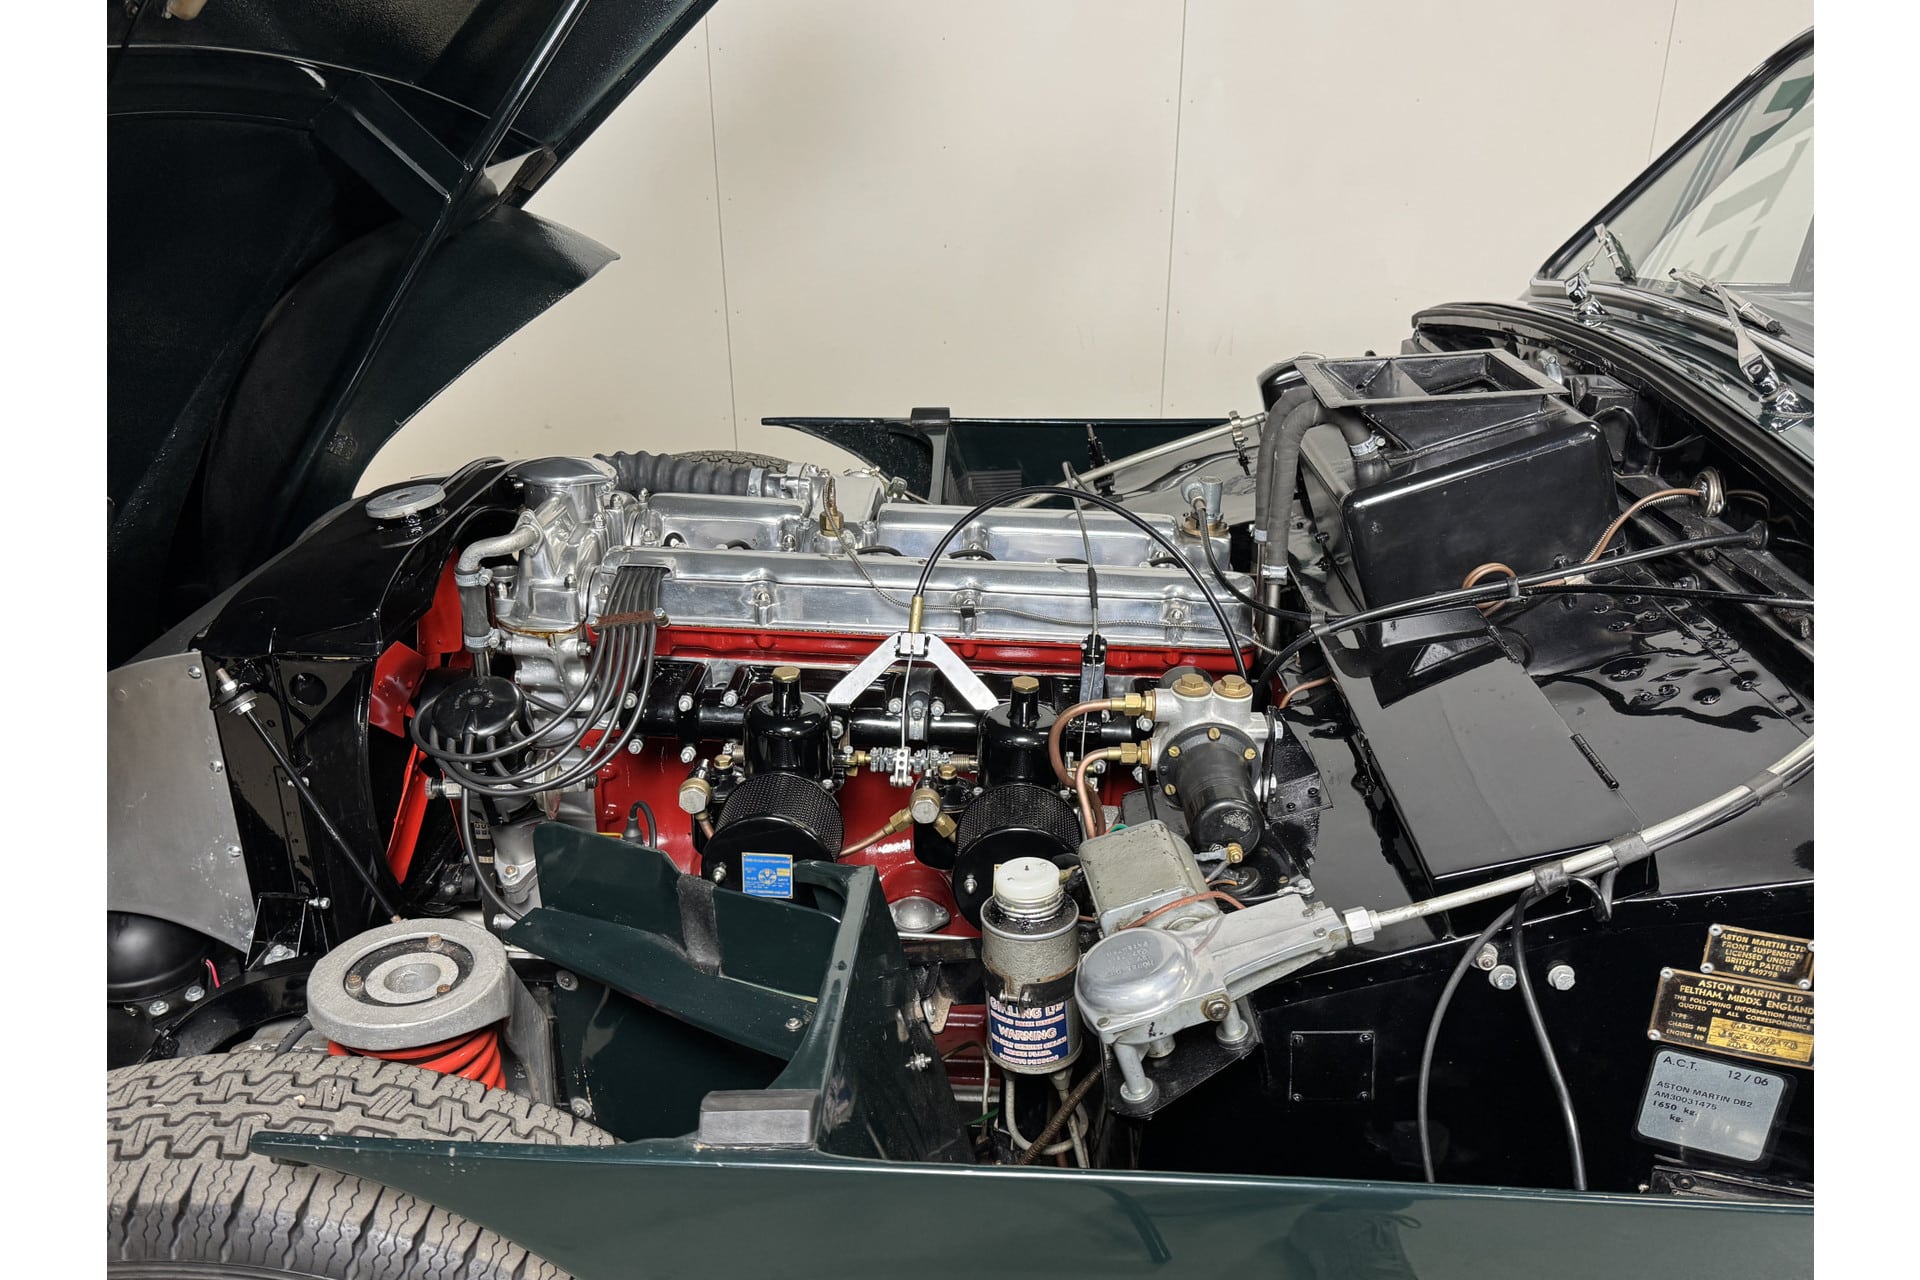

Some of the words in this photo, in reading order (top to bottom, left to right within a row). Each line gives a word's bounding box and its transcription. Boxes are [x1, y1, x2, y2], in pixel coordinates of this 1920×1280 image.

[1720, 933, 1749, 944] ASTON
[1752, 938, 1787, 950] MARTIN
[1721, 941, 1750, 951] FRONT
[1752, 946, 1803, 960] SUSPENSION
[1725, 949, 1763, 961] LICENSED
[1766, 956, 1796, 967] UNDER
[1725, 956, 1756, 967] BRITISH
[1759, 962, 1792, 973] PATENT
[1699, 979, 1735, 992] ASTON
[1740, 987, 1781, 1000] MARTIN
[1678, 1001, 1707, 1012] QUOTED
[1679, 984, 1724, 1000] FELTHAM,
[1727, 993, 1762, 1007] MIDDX.
[1766, 1000, 1814, 1015] ENGLAND
[1689, 997, 1732, 1009] FOLLOWING
[1734, 1005, 1785, 1019] INFORMATION
[1787, 1014, 1808, 1023] MUST
[997, 1023, 1057, 1041] WARNING
[1663, 1056, 1698, 1071] A.C.T.
[1654, 1090, 1717, 1111] AM30031475
[1656, 1080, 1690, 1094] ASTON
[1692, 1089, 1731, 1103] MARTIN
[1733, 1098, 1753, 1108] DB2
[1652, 1100, 1677, 1111] 1650
